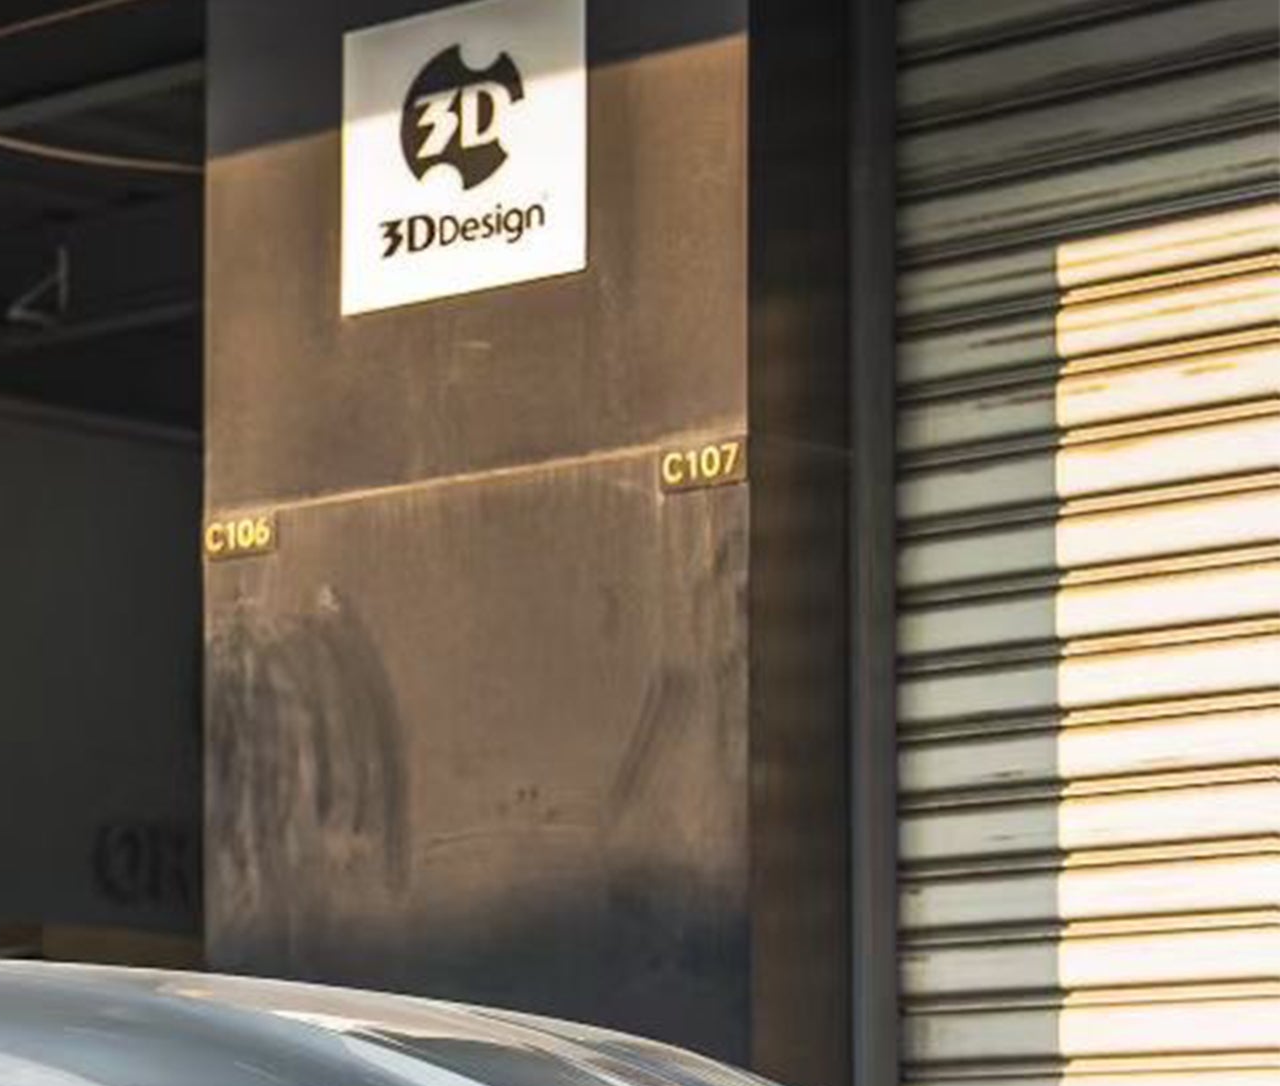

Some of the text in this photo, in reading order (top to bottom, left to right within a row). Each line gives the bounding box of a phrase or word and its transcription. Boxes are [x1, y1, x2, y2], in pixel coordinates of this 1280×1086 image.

[414, 81, 513, 161] 3D
[662, 442, 739, 484] C107
[205, 515, 272, 552] C106
